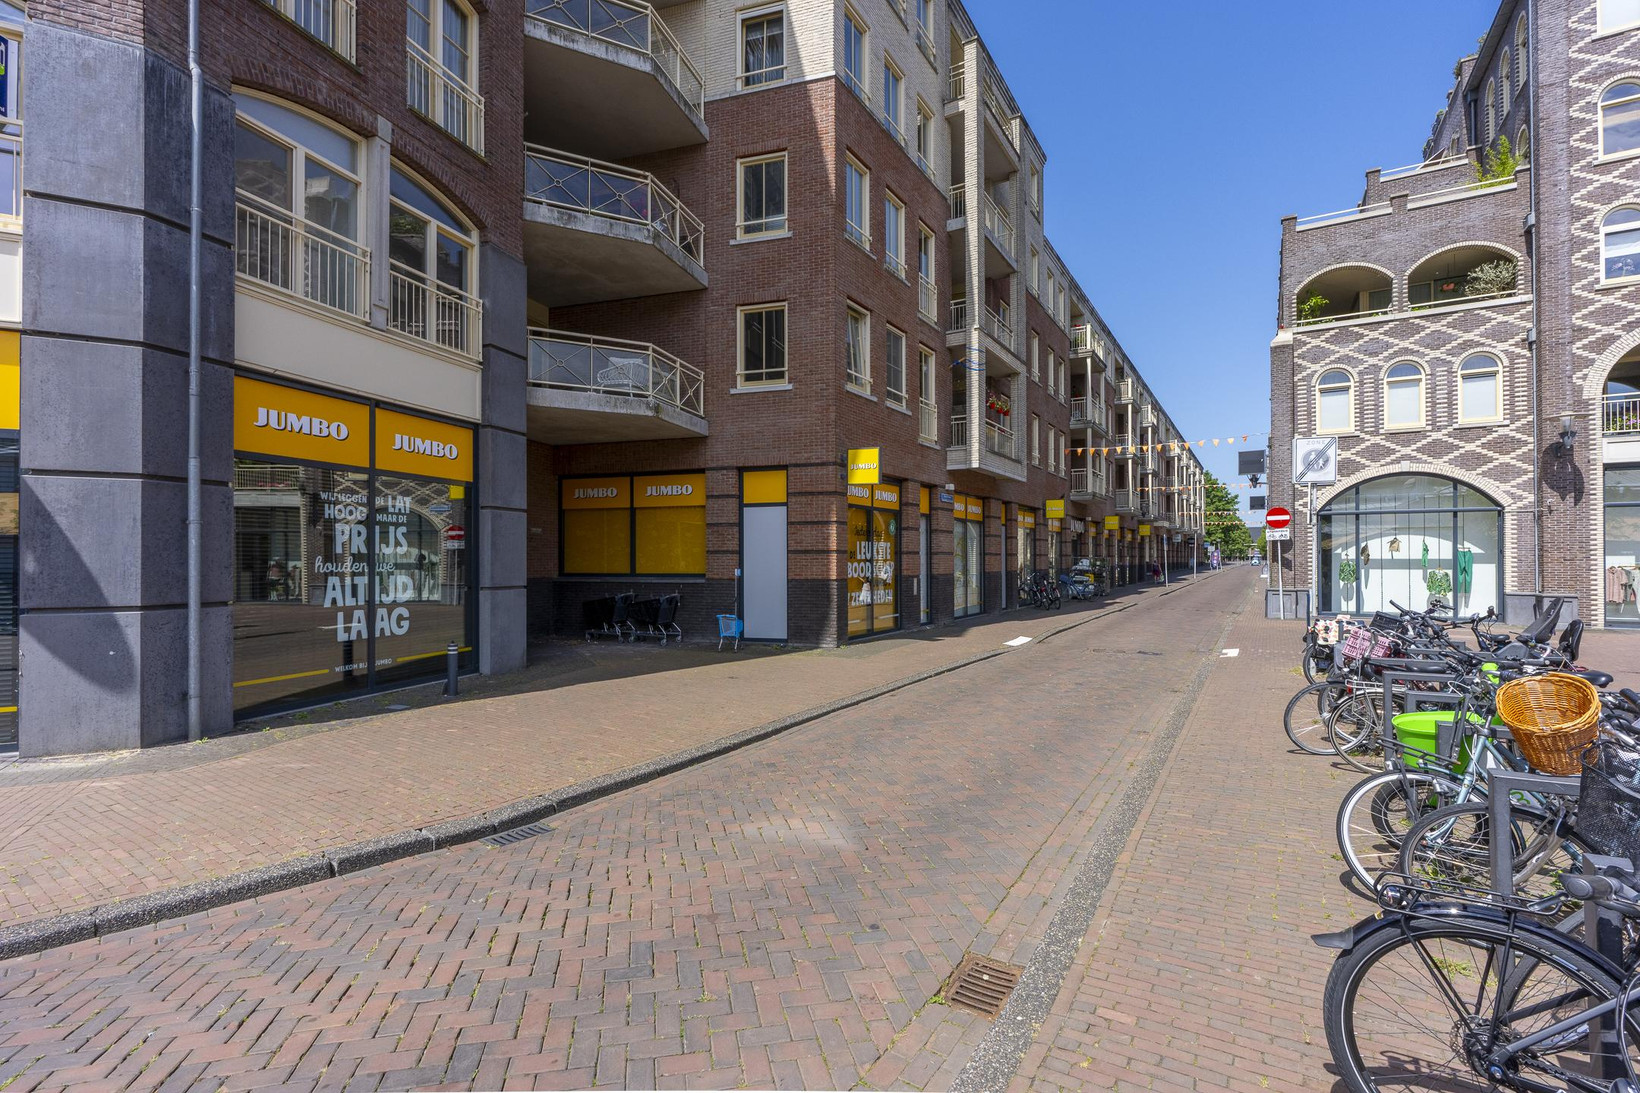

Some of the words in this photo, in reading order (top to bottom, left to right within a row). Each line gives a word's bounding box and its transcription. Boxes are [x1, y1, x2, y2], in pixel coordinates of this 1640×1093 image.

[253, 407, 349, 441] JUMBO
[392, 434, 458, 460] JUMBO
[850, 462, 877, 470] JUMBO
[573, 487, 617, 499] JUMBO
[645, 484, 693, 497] JUMBO
[848, 485, 869, 498] UMBO
[875, 490, 897, 503] JUMBO
[320, 491, 335, 501] WIJ
[338, 493, 367, 503] LEGGEN
[375, 496, 385, 505] DE
[388, 495, 412, 513] LAT
[324, 503, 367, 520] HOOG
[376, 513, 397, 522] MAAR
[398, 515, 407, 523] DE
[335, 523, 408, 555] PRIJS
[856, 541, 891, 560] LEUKSTE
[314, 555, 368, 573] houden
[376, 562, 396, 572] we
[323, 574, 415, 608] ALTIJD
[337, 606, 410, 642] LAAG
[335, 664, 358, 673] WELKOM
[375, 658, 393, 666] JUMBO
